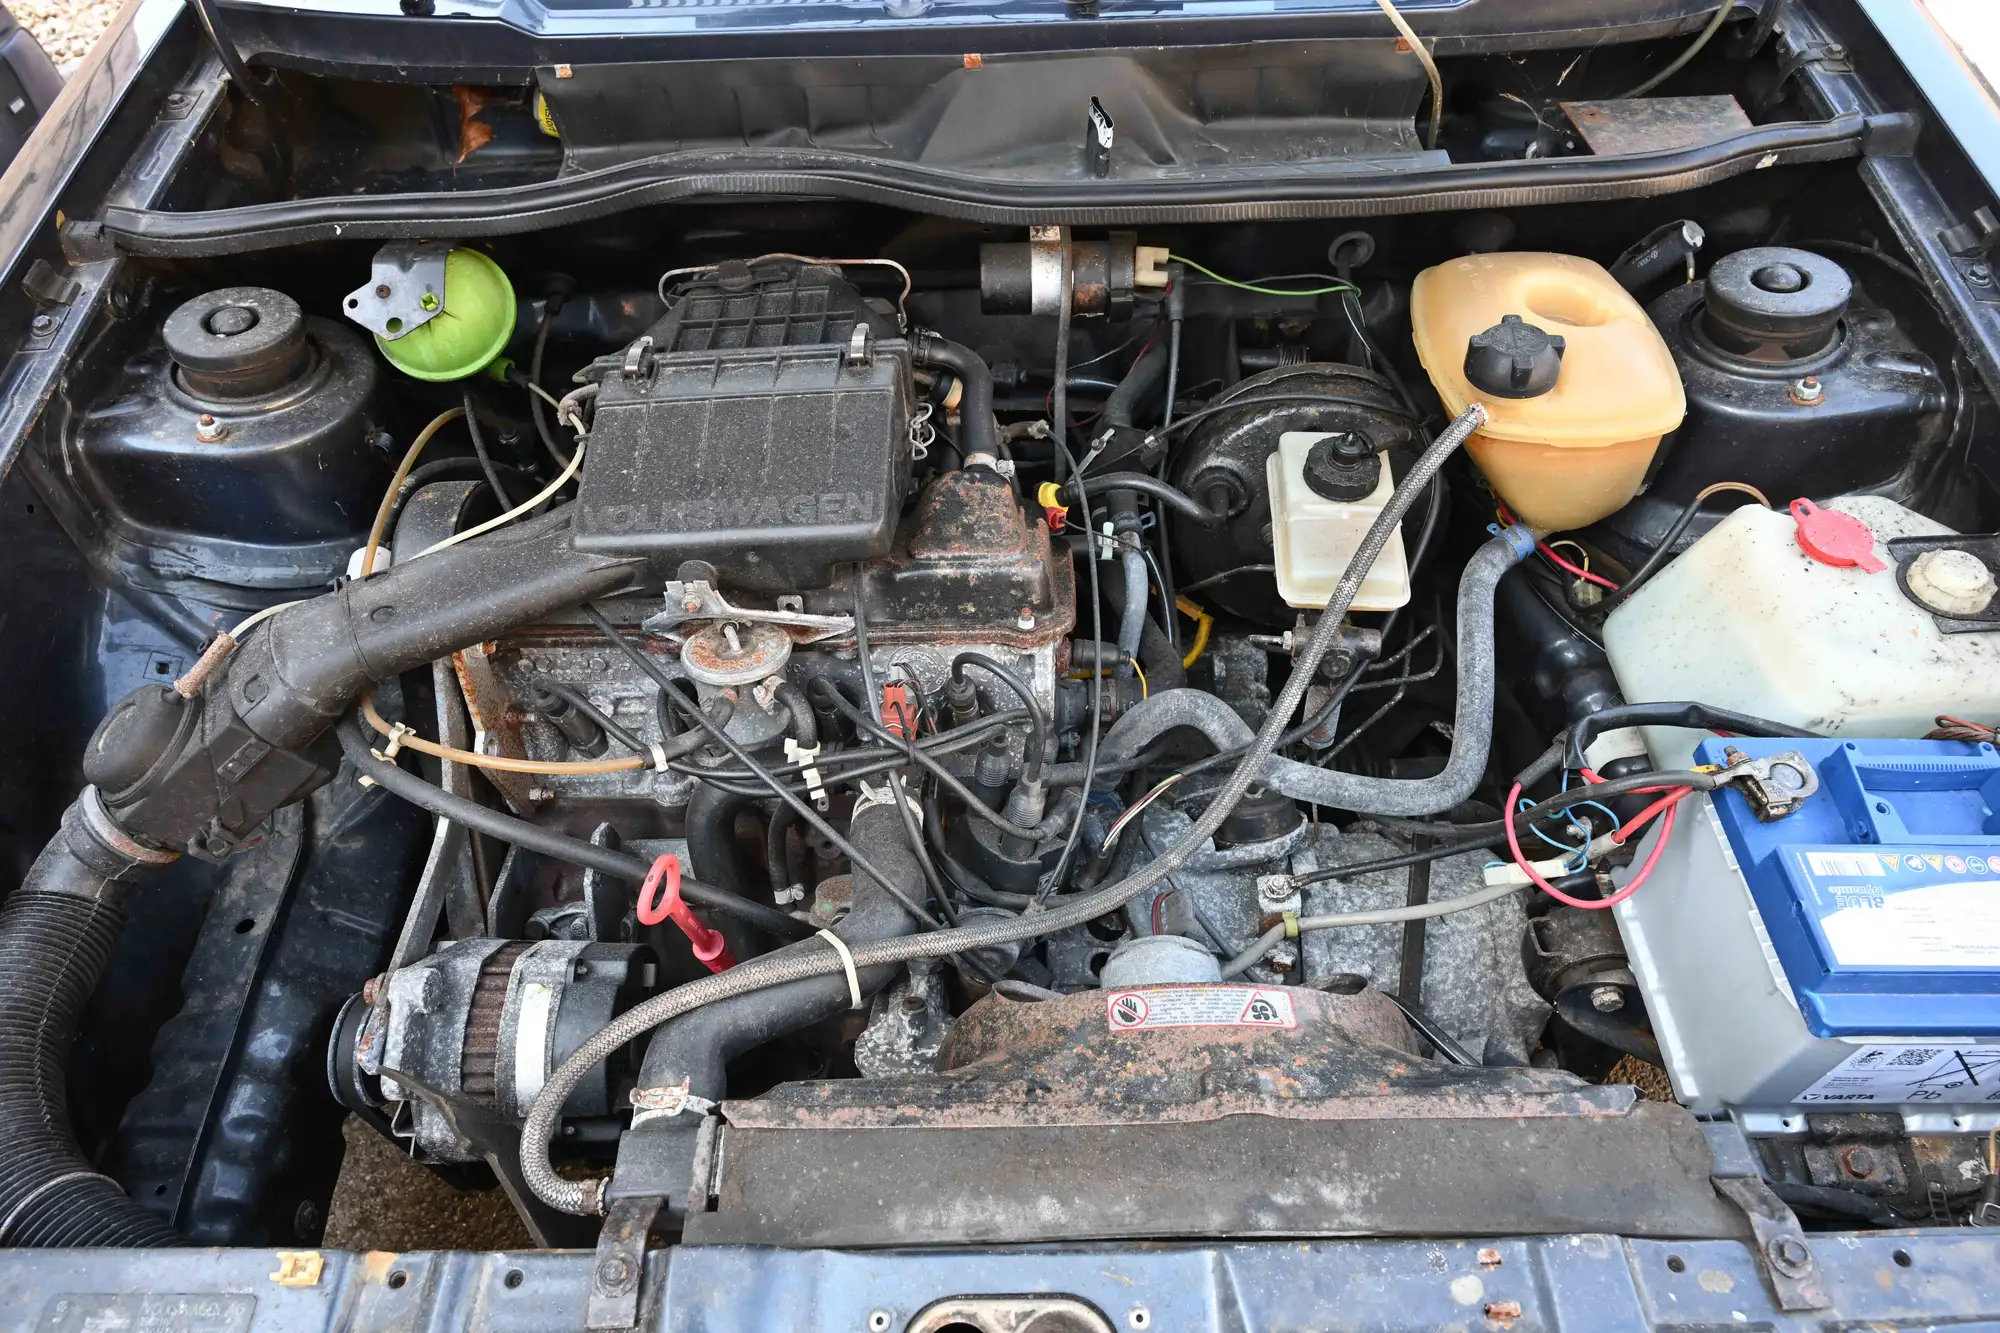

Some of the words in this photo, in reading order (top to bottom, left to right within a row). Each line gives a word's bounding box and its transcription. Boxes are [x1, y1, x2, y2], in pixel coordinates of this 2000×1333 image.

[1828, 884, 1883, 896] Dynamic
[1835, 895, 1885, 910] BLUE
[1906, 1090, 1942, 1100] Pb
